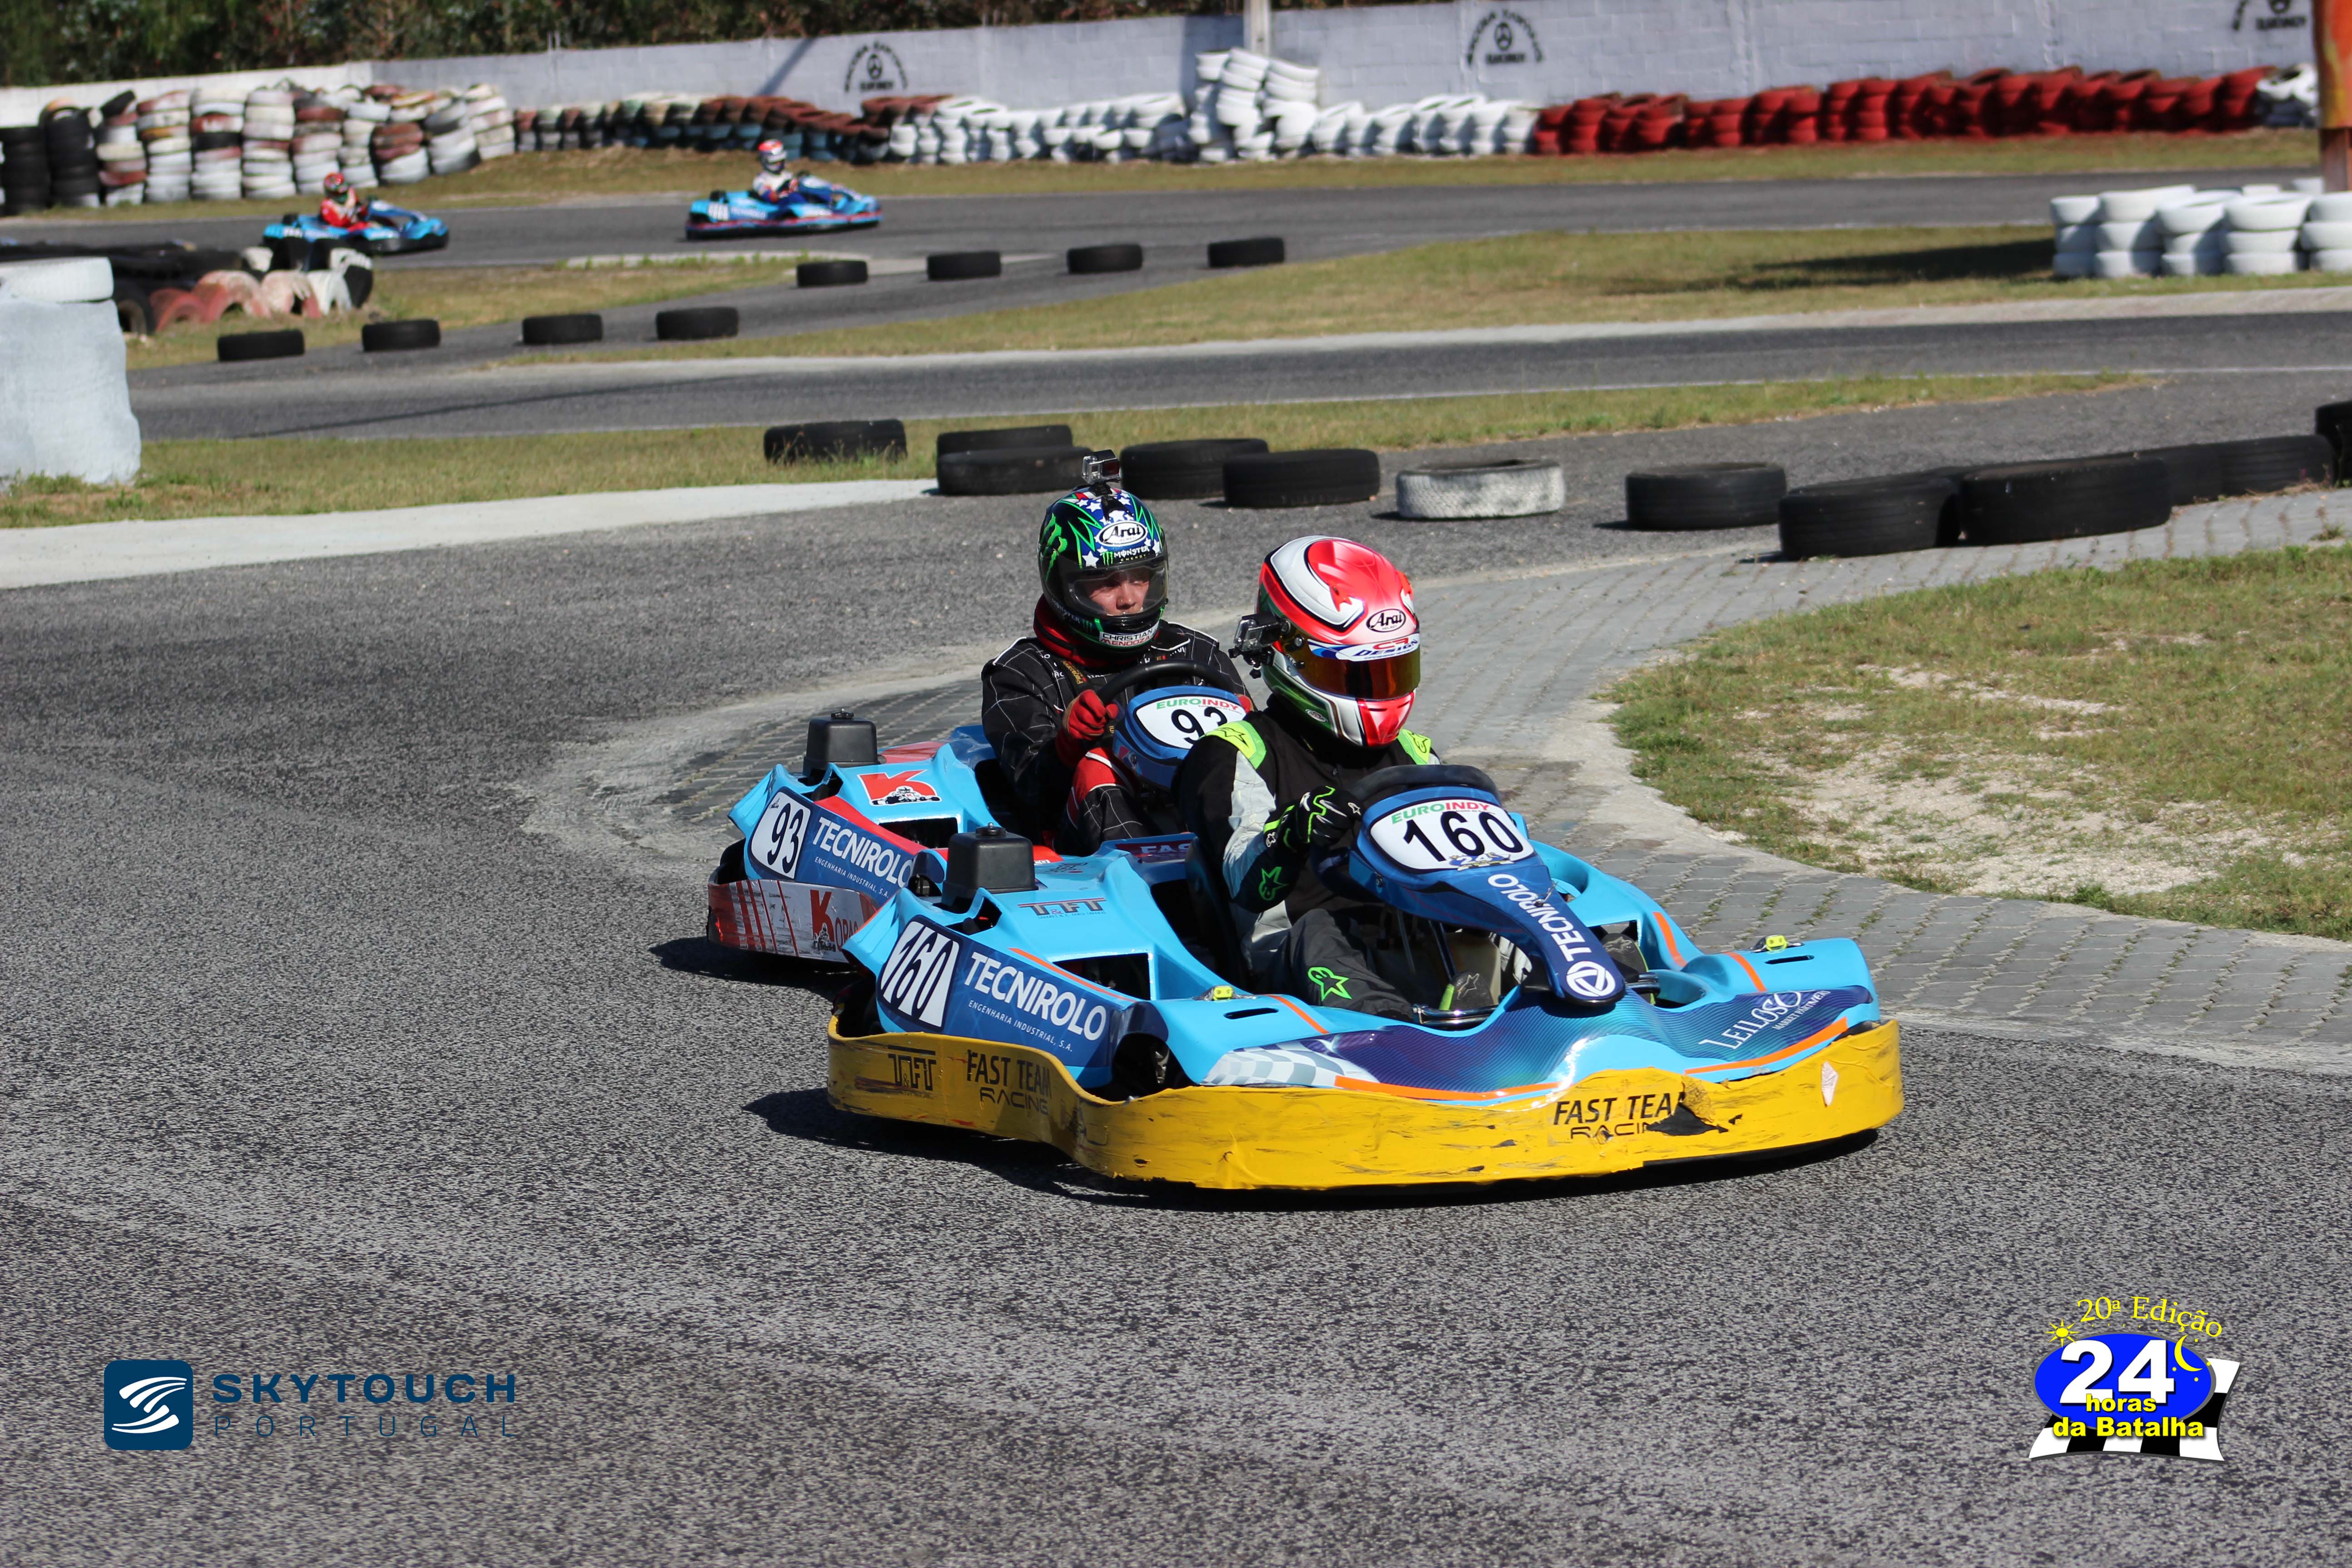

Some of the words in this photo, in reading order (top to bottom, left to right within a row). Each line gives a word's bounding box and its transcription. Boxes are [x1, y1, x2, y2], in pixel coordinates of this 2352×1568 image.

[1103, 523, 1141, 543] Arai
[1102, 629, 1152, 641] CHRISTIAN
[1370, 611, 1402, 628] Arai
[1100, 635, 1151, 646] MENDOZA
[1352, 639, 1418, 657] DESIGN
[1156, 698, 1239, 710] EUROINDY
[1392, 802, 1490, 824] EUROINDY
[767, 803, 804, 874] 93
[813, 817, 914, 888] TECNIROLO
[1140, 843, 1191, 854] FAS
[1403, 811, 1523, 862] 160
[815, 857, 846, 876] ENGENHARIA
[847, 872, 877, 894] INDUSTRIAL,
[877, 890, 889, 899] S.A.
[1488, 874, 1592, 962] TECNIROLO
[882, 925, 953, 1020] 160
[965, 951, 1107, 1040] TECNIROLO
[1772, 1012, 1799, 1030] MARKET
[1796, 990, 1831, 1014] PARTNERS
[968, 1000, 1012, 1024] ENGENHARIA
[1014, 1020, 1057, 1046] INDUSTRIAL,
[1058, 1038, 1073, 1052] S.A.
[967, 1049, 1010, 1087] FAST
[1017, 1059, 1051, 1098] TEAM
[980, 1087, 1049, 1115] RACING
[1553, 1098, 1617, 1125] FAST
[1628, 1093, 1684, 1119] TEA
[1571, 1122, 1651, 1139] RACI
